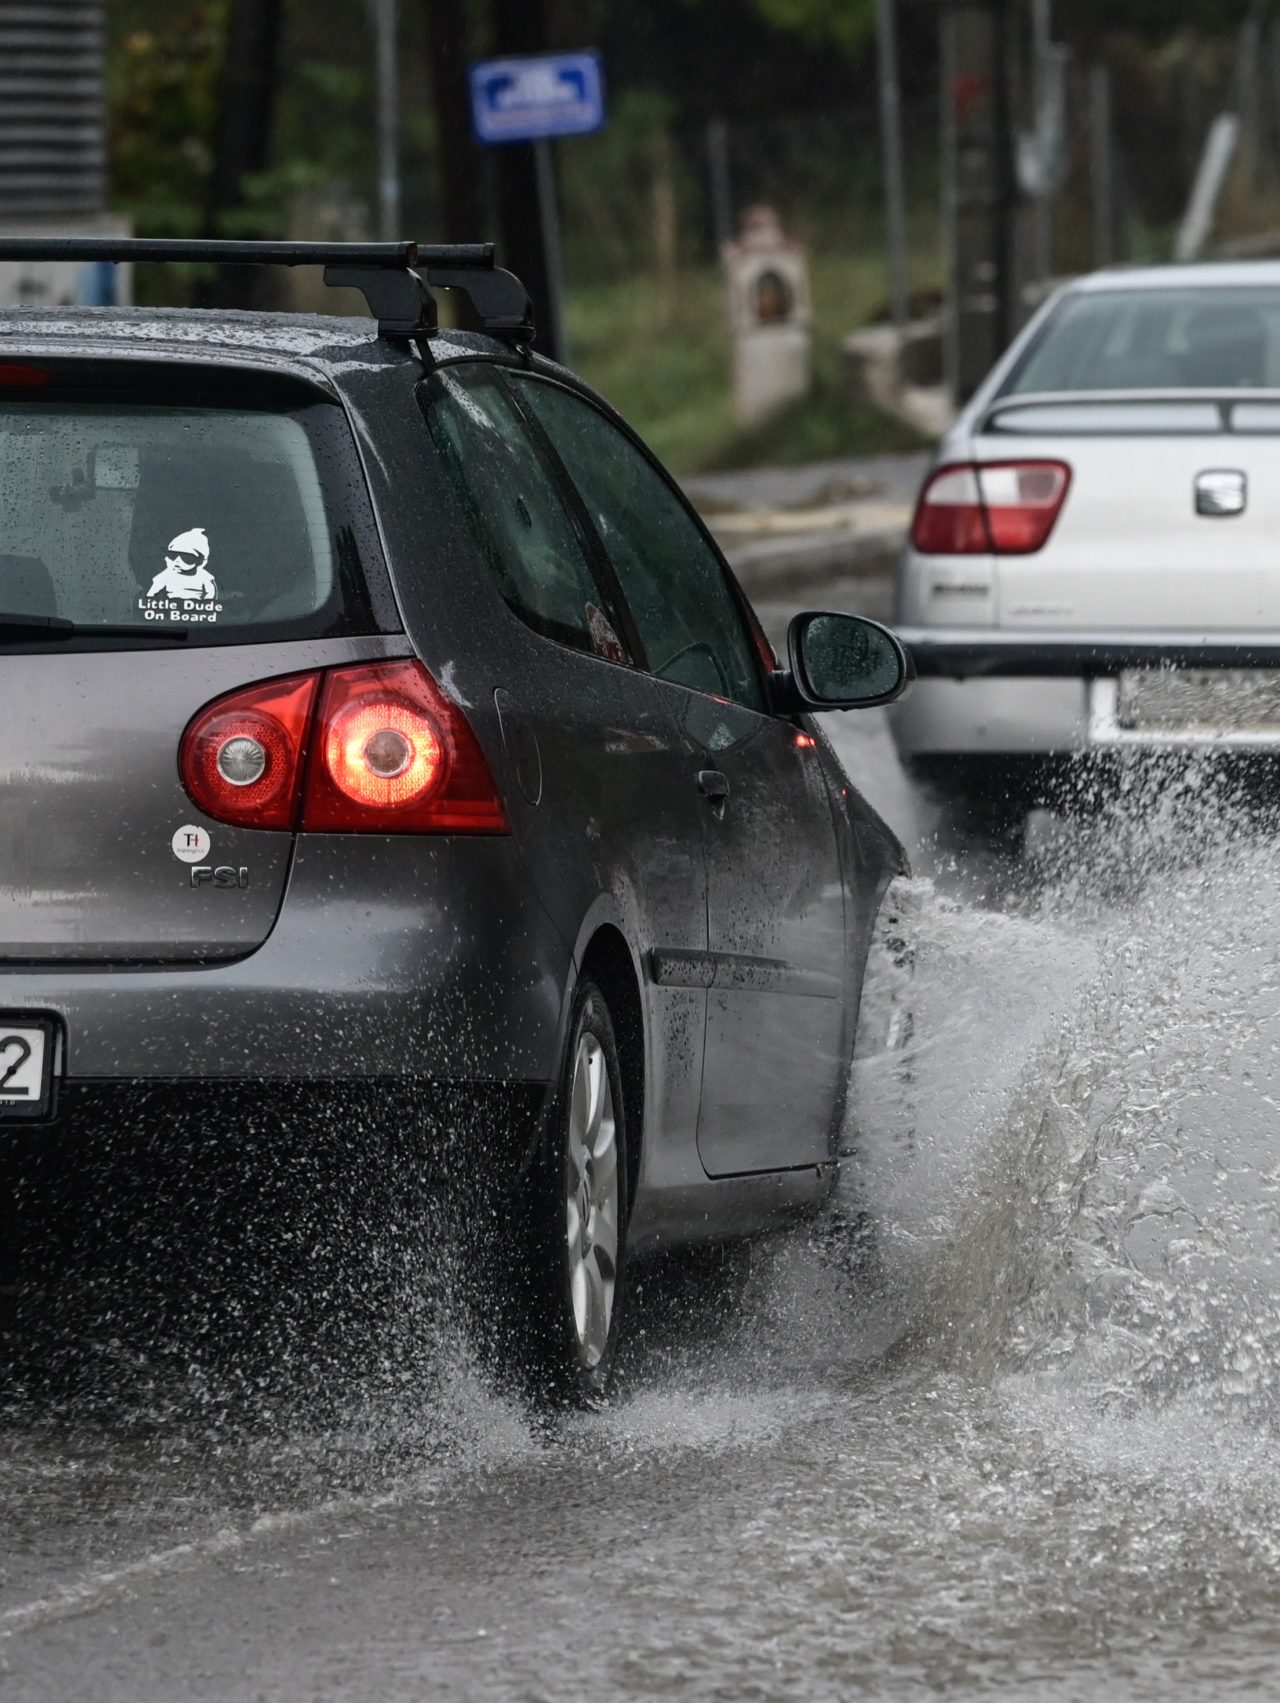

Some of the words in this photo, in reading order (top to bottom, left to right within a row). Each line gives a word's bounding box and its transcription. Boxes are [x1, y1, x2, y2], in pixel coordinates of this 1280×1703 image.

[138, 599, 178, 610] Little
[183, 600, 223, 612] Dude
[144, 610, 164, 621] On
[170, 611, 217, 622] Board
[190, 866, 249, 889] FSI
[0, 1035, 31, 1096] 2
